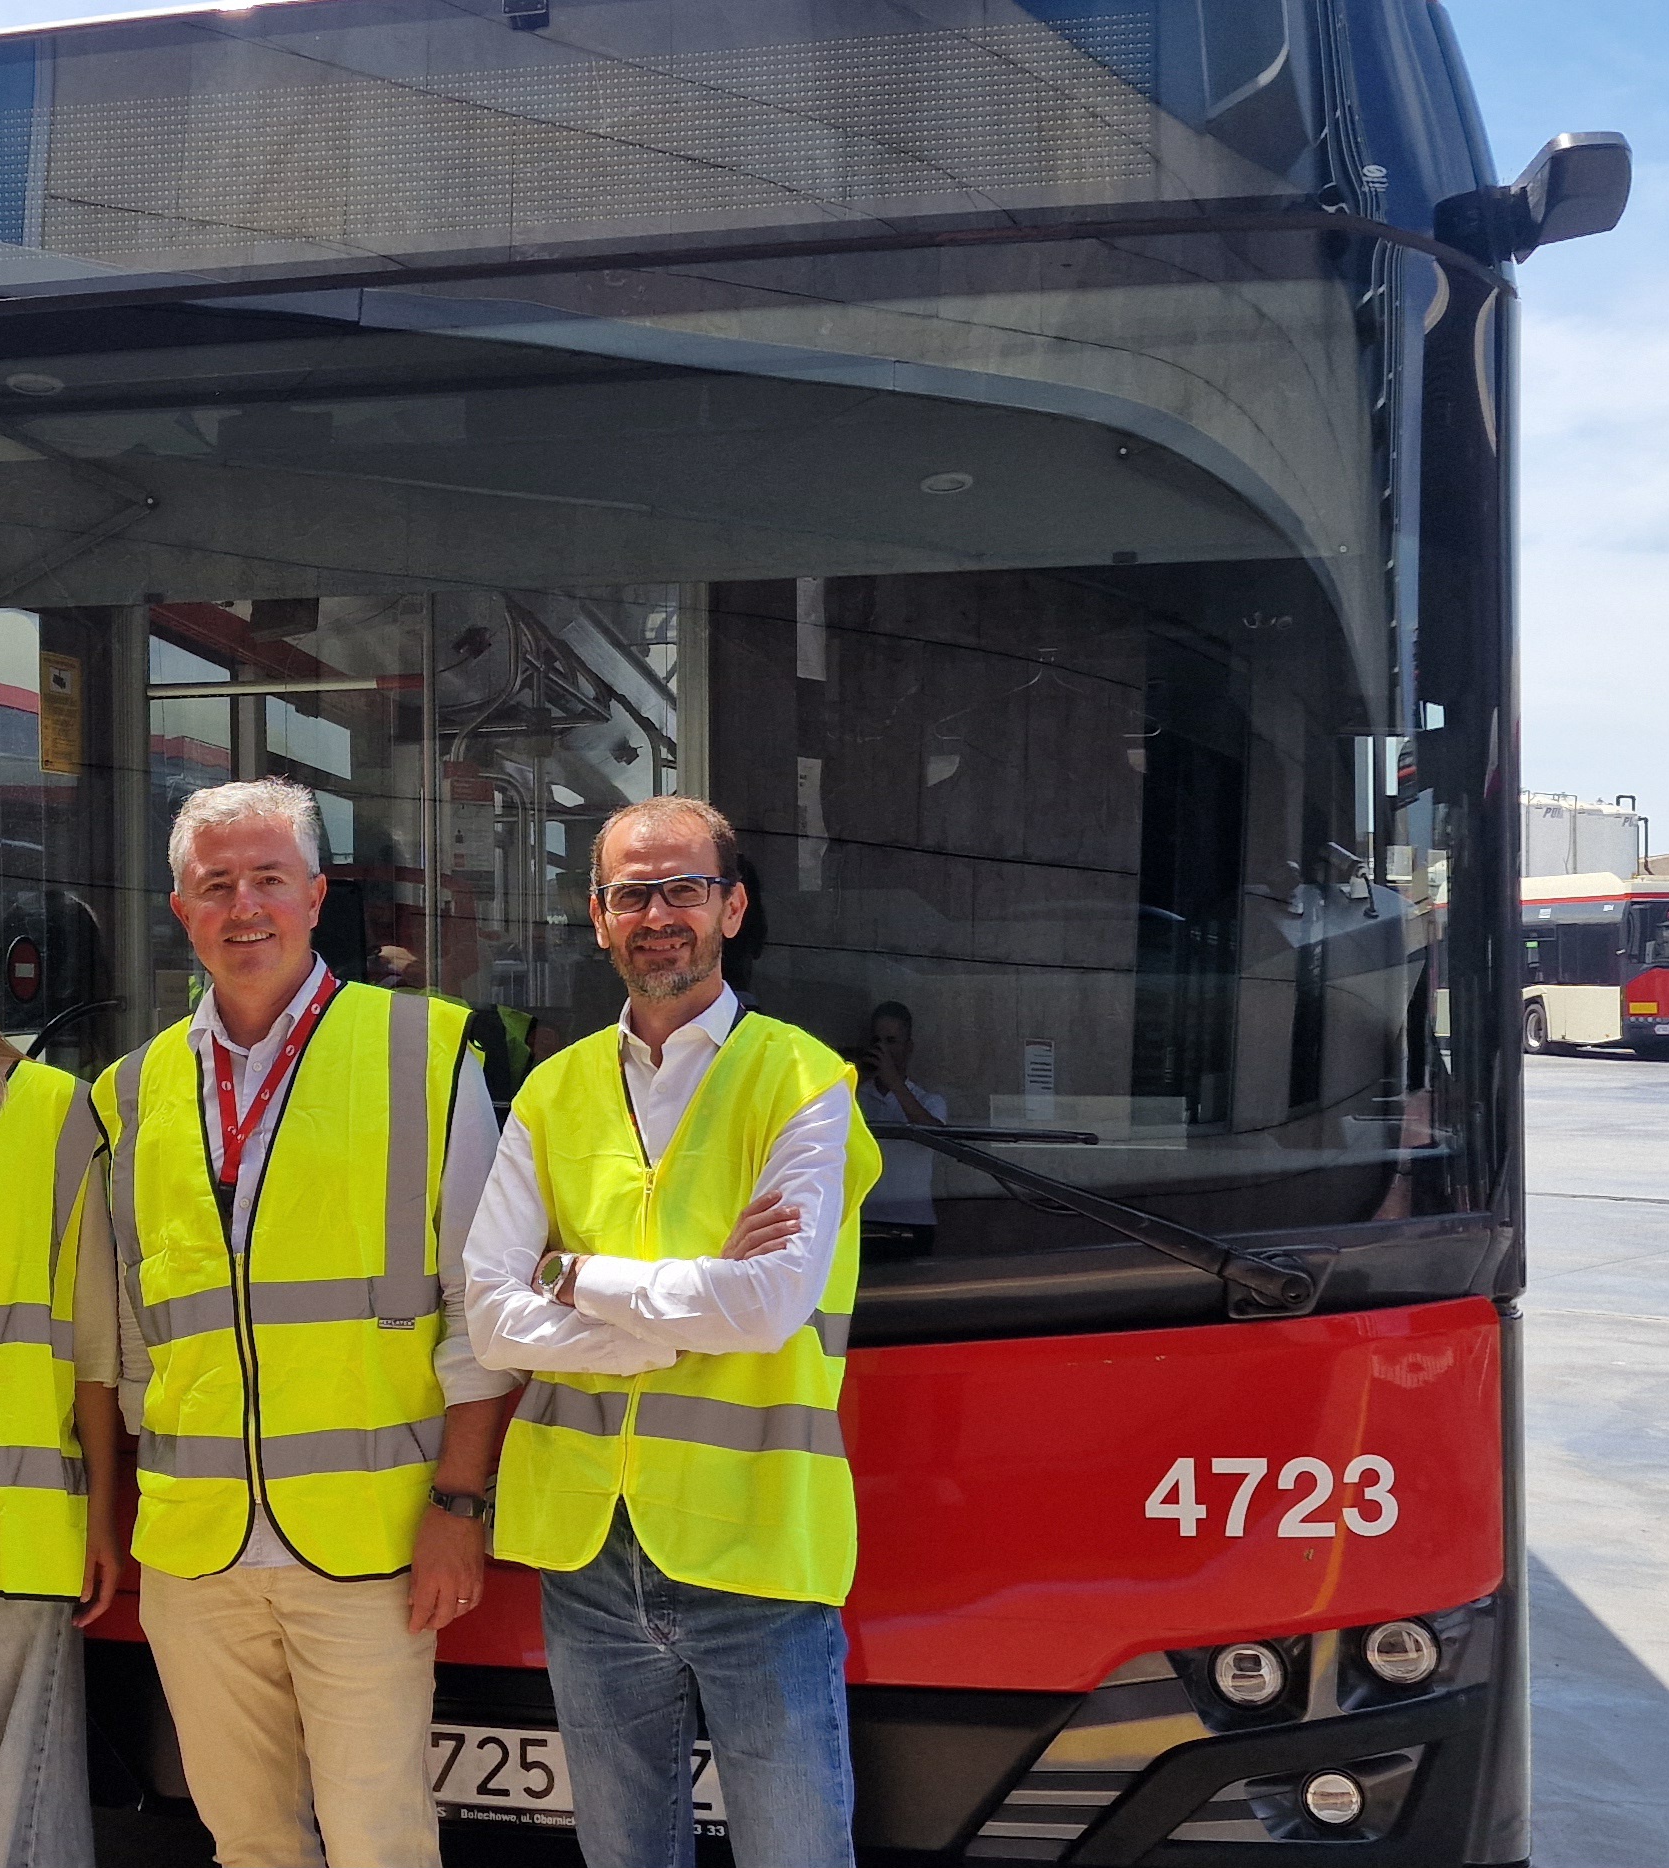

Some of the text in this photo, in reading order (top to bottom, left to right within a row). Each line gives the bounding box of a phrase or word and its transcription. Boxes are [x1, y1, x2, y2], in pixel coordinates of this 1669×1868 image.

[1144, 1454, 1399, 1538] 4723
[431, 1732, 555, 1799] 725
[706, 1825, 725, 1837] 33
